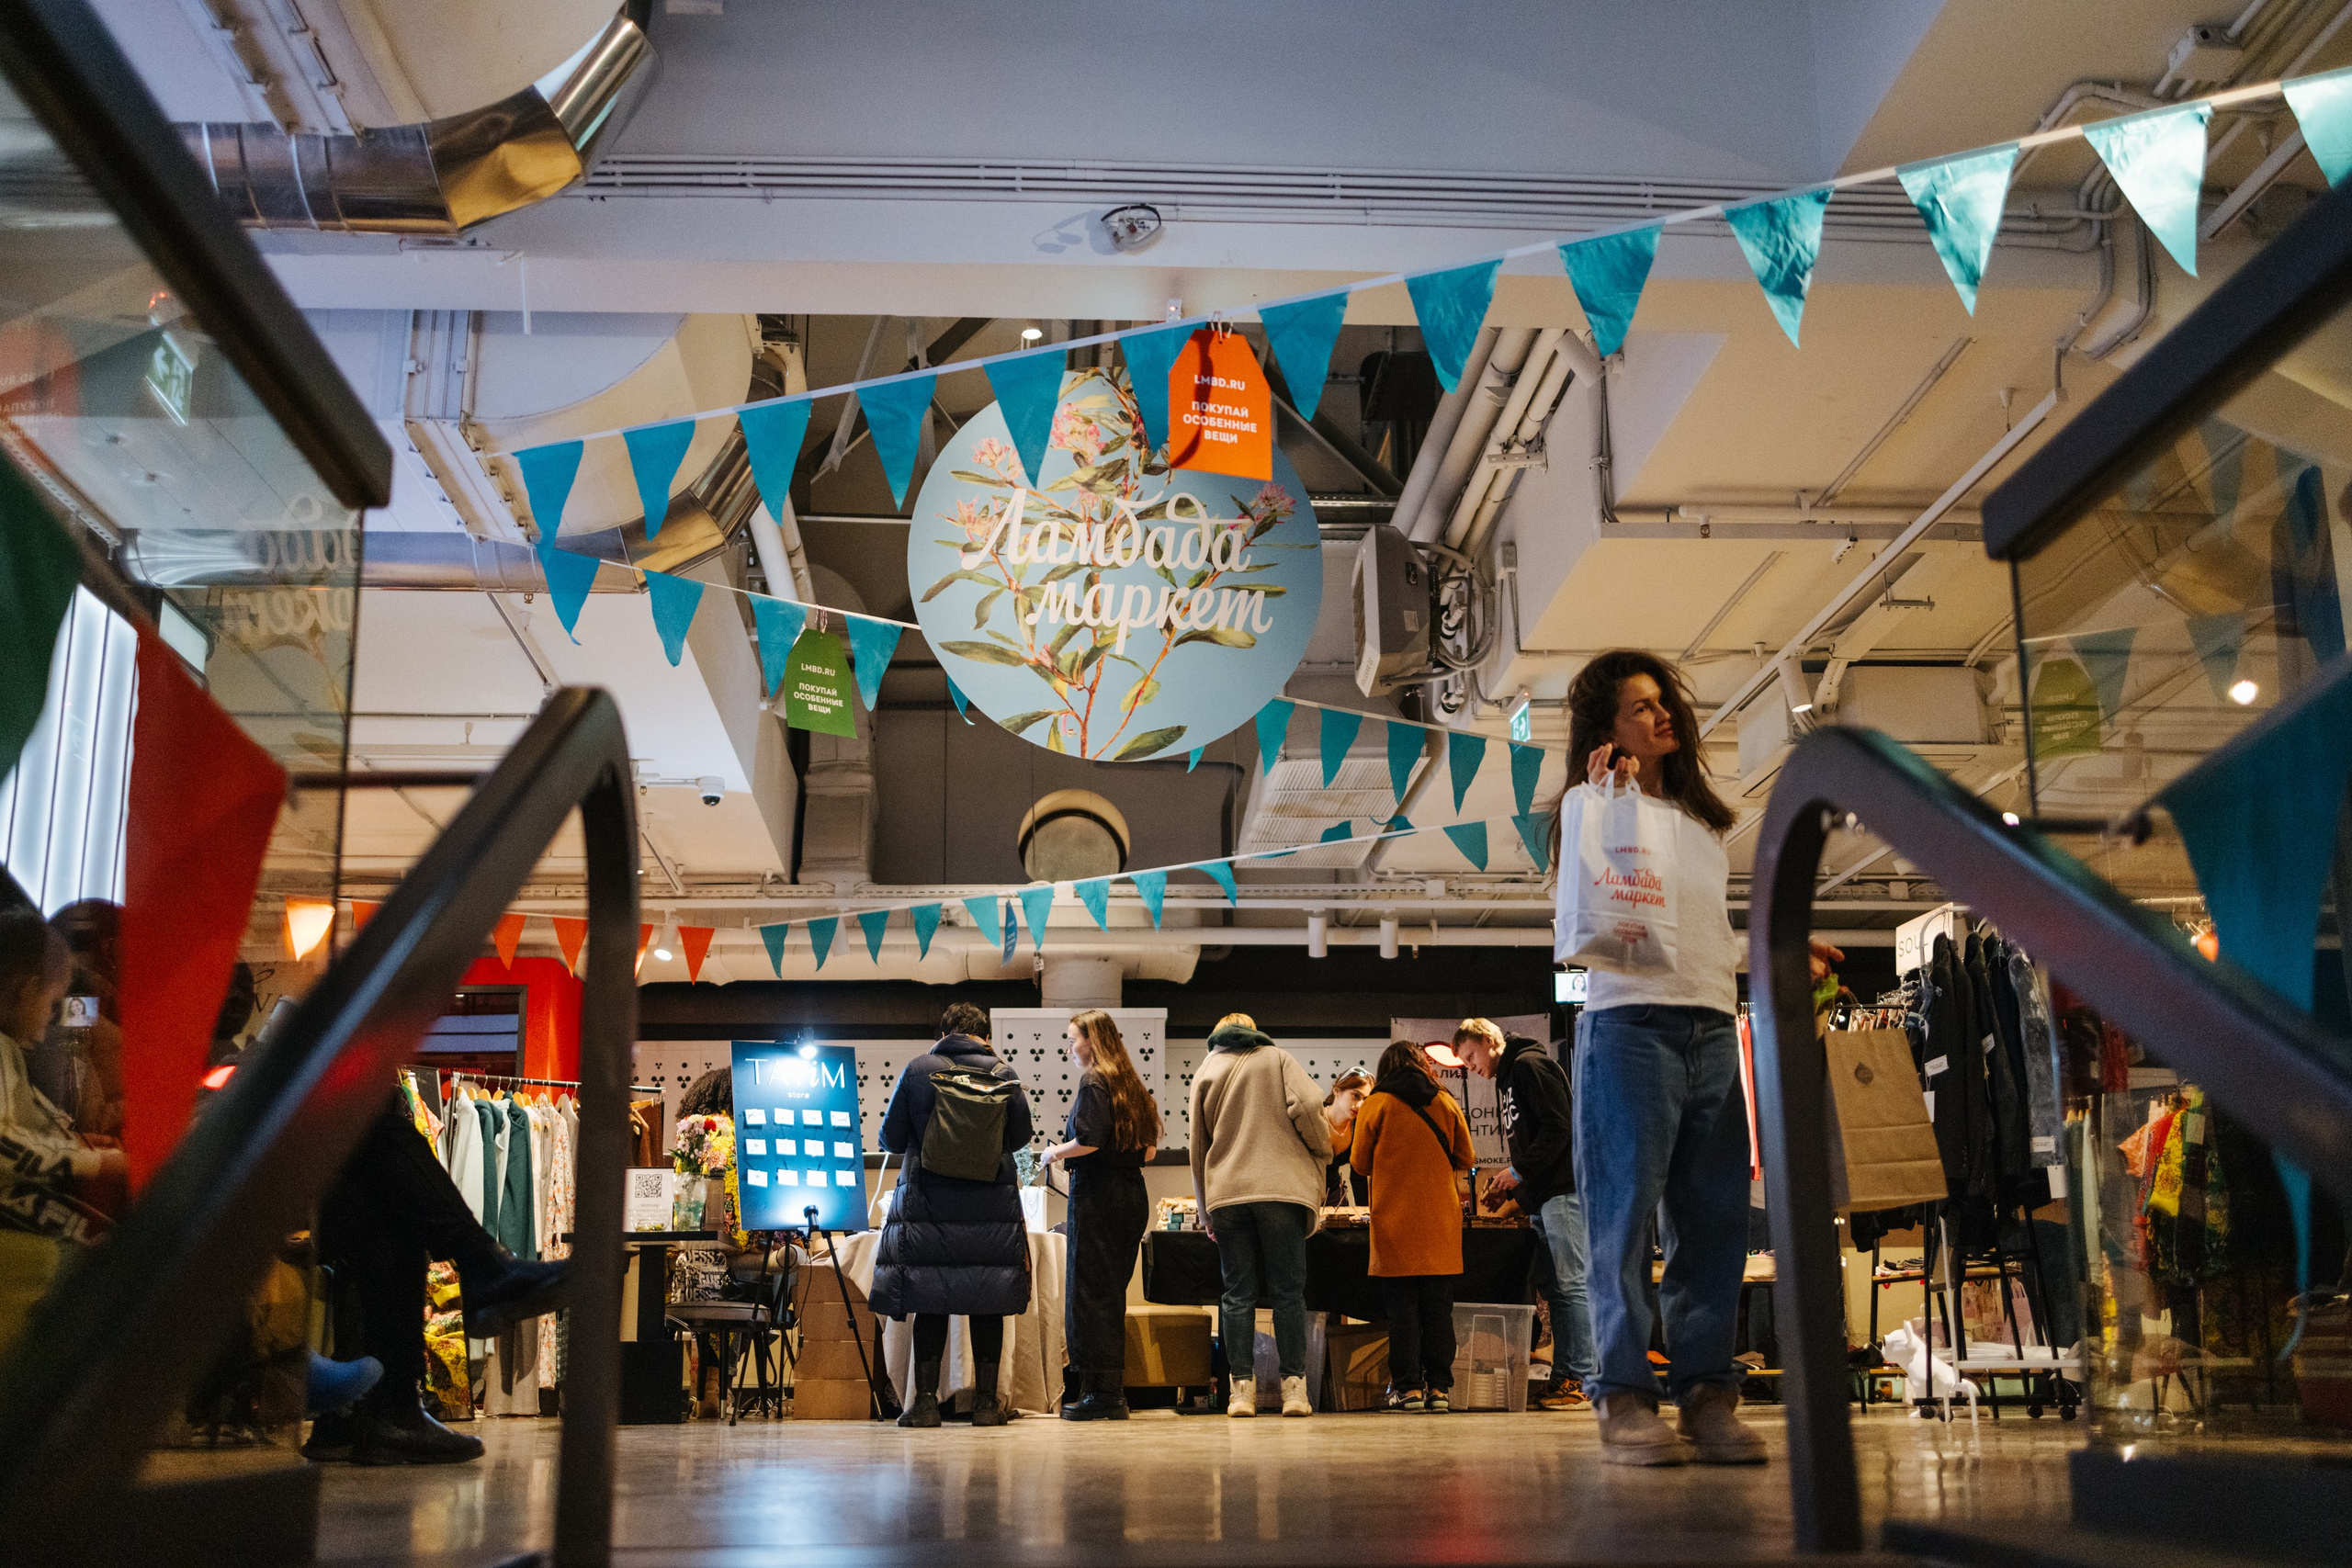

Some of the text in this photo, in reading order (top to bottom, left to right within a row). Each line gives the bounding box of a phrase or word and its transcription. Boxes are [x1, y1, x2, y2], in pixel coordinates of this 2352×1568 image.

[1194, 375, 1246, 391] LMBD.RU
[1192, 400, 1250, 418] ПОКУПАЙ
[1182, 414, 1258, 433] ОСОБЕННЫЕ
[1204, 430, 1238, 444] ВЕЩИ
[961, 488, 1254, 573] Ламбада
[1025, 580, 1273, 656] маркет
[800, 663, 836, 677] LMBD.RU
[799, 682, 838, 696] ПОКУПАЙ
[794, 692, 843, 707] ОСОБЕННЫЕ
[808, 704, 831, 714] ВЕЩИ
[1594, 866, 1664, 892] Ламбада
[1610, 888, 1667, 909] маркет
[745, 1057, 845, 1089] TAiM
[787, 1091, 810, 1100] store
